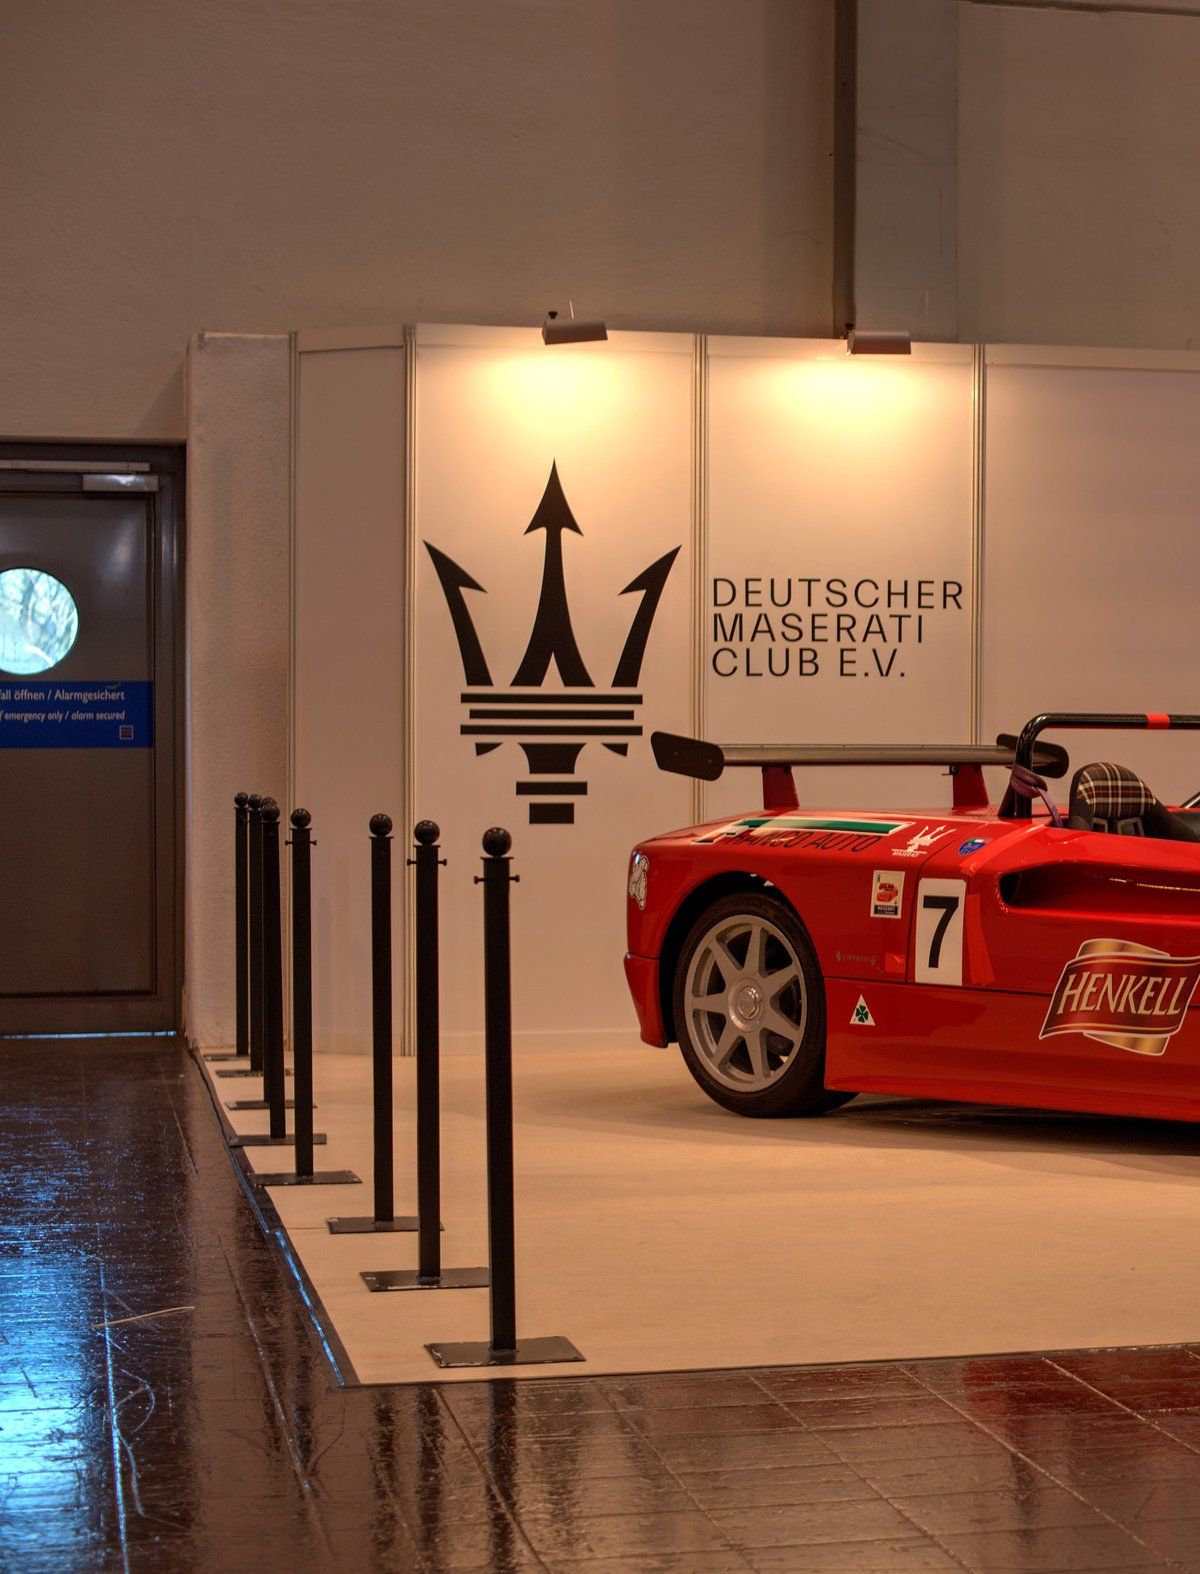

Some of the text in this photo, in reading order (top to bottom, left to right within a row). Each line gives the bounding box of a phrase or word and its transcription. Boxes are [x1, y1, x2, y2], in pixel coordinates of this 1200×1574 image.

[713, 577, 963, 609] DEUTSCHER
[713, 612, 923, 643] MASERATI
[712, 647, 905, 677] CLUB E.V.
[14, 689, 45, 700] öffnen
[54, 689, 126, 703] Alarmgesichert
[5, 713, 46, 723] emergency
[47, 711, 64, 722] only
[71, 711, 94, 720] alarm
[95, 711, 126, 720] secured
[805, 832, 882, 852] AUTO
[922, 895, 960, 968] 7
[1056, 972, 1188, 1016] HENKELL
